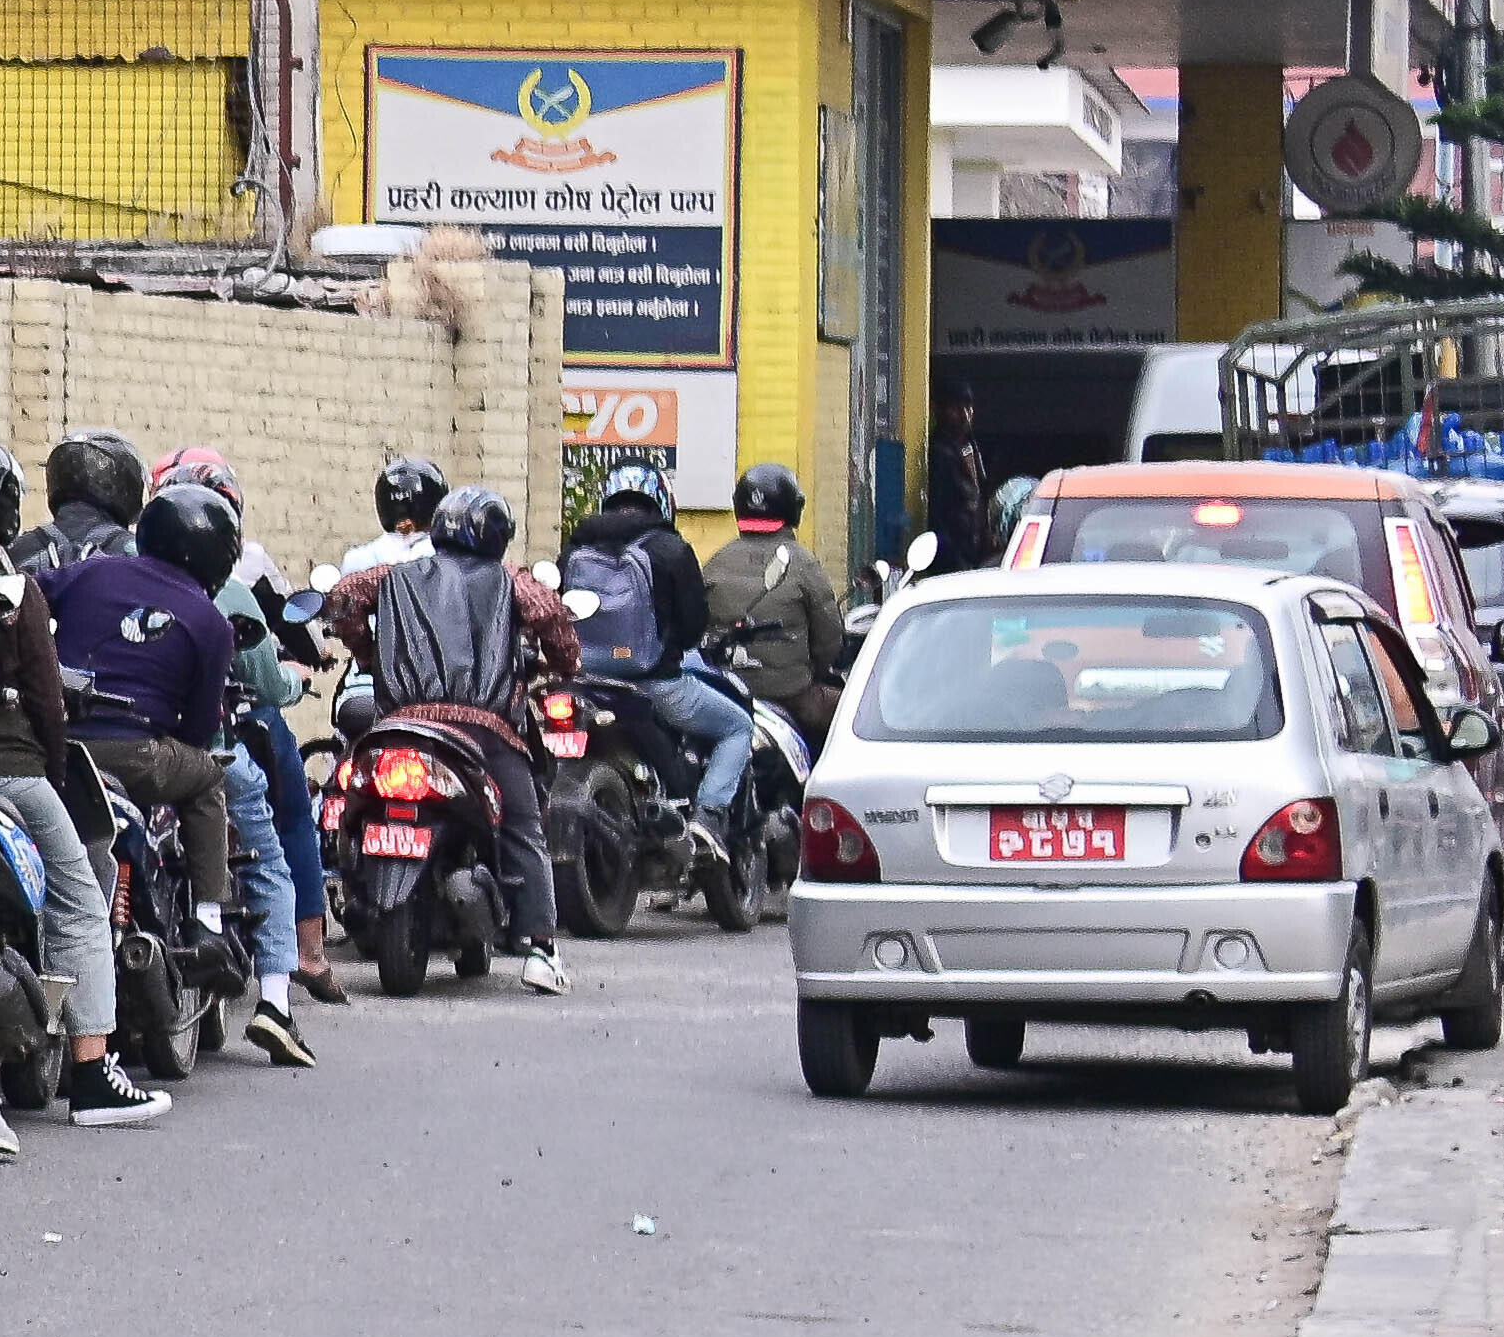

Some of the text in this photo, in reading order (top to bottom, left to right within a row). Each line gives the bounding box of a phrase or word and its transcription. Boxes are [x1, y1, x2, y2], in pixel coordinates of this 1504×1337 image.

[386, 182, 716, 219] प्रहरी कल्याण कोष पेट्रोल पम्प
